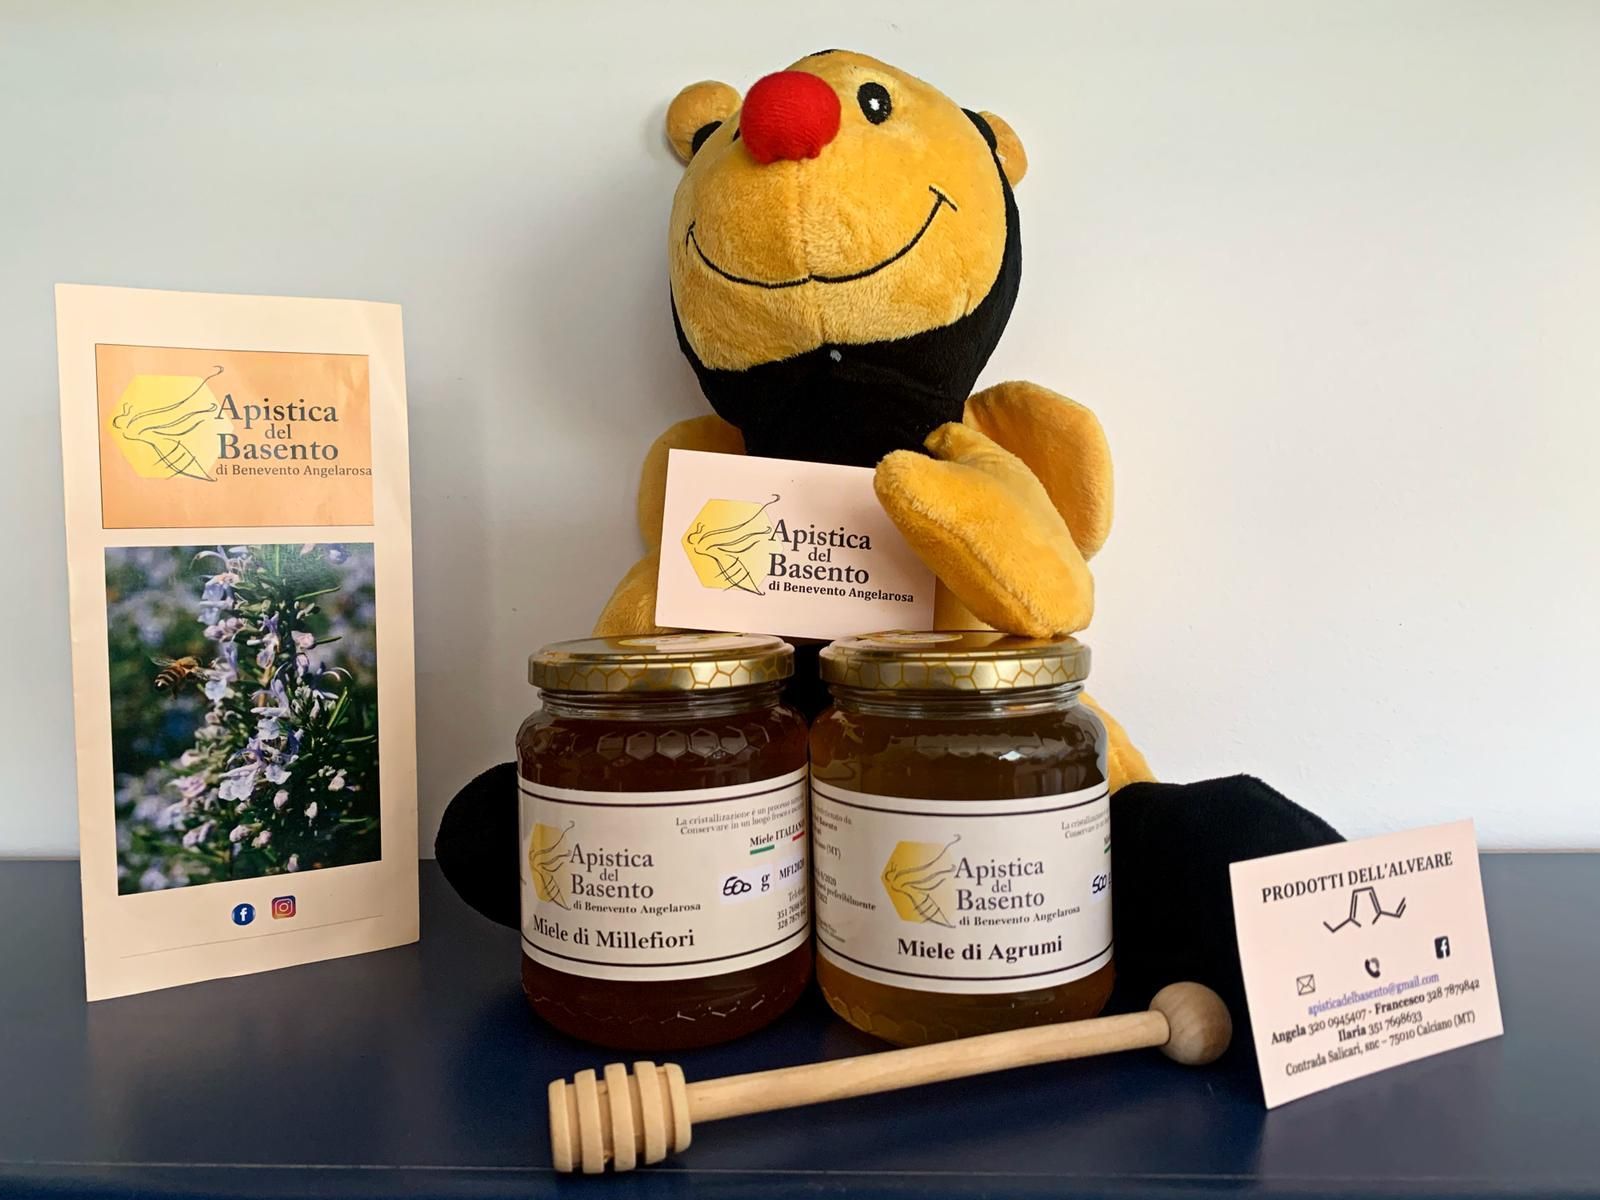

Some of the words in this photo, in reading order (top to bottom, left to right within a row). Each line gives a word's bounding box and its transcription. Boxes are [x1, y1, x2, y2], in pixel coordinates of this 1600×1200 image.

[214, 393, 339, 430] Apistica
[264, 423, 292, 440] del
[216, 433, 339, 460] Basento
[215, 464, 228, 475] di
[232, 464, 300, 476] Benevento
[303, 465, 373, 478] Angelarosa
[768, 518, 872, 551] Apistica
[767, 552, 870, 584] Basento
[807, 547, 832, 563] del
[768, 581, 781, 592] di
[783, 582, 846, 597] Benevento
[848, 588, 914, 602] Angelarosa
[675, 817, 688, 826] La
[680, 822, 729, 835] Conservare
[750, 833, 774, 848] Miele
[569, 843, 655, 872] Apistica
[599, 868, 619, 881] del
[761, 873, 770, 892] g
[953, 857, 1045, 886] Apistica
[1261, 872, 1345, 904] PRODOTTI
[1348, 851, 1454, 886] DELL'ALVEARE
[570, 873, 654, 899] Basento
[991, 878, 1013, 893] del
[573, 900, 582, 911] di
[584, 901, 637, 914] Benevento
[640, 901, 701, 916] Angelarosa
[956, 888, 1045, 911] Basento
[959, 916, 970, 926] di
[974, 915, 1031, 927] Benevento
[1033, 906, 1081, 923] Angelarosa
[533, 913, 569, 942] Miele
[573, 927, 590, 945] di
[596, 928, 696, 949] Millefiori
[897, 938, 956, 960] Miele
[961, 942, 982, 960] di
[987, 934, 1063, 964] Agrumi
[1307, 971, 1440, 1017] apisticadelbasento@gmail.com
[1271, 1024, 1307, 1045] Angela
[1308, 1019, 1326, 1036] 320
[1327, 1007, 1368, 1032] 0945407
[1374, 993, 1426, 1015] Francesco
[1426, 987, 1443, 1003] 328
[1444, 978, 1481, 998] 7879842
[1337, 1024, 1367, 1042] Ilaria
[1368, 1021, 1384, 1036] 351
[1385, 1010, 1424, 1033] 7698633
[1285, 1054, 1328, 1077] Contrada
[1328, 1041, 1364, 1064] Salicari,
[1364, 1038, 1381, 1051] snc
[1388, 1028, 1416, 1047] 75010
[1416, 1018, 1454, 1039] Calciano
[1453, 1009, 1476, 1028] (MT)
